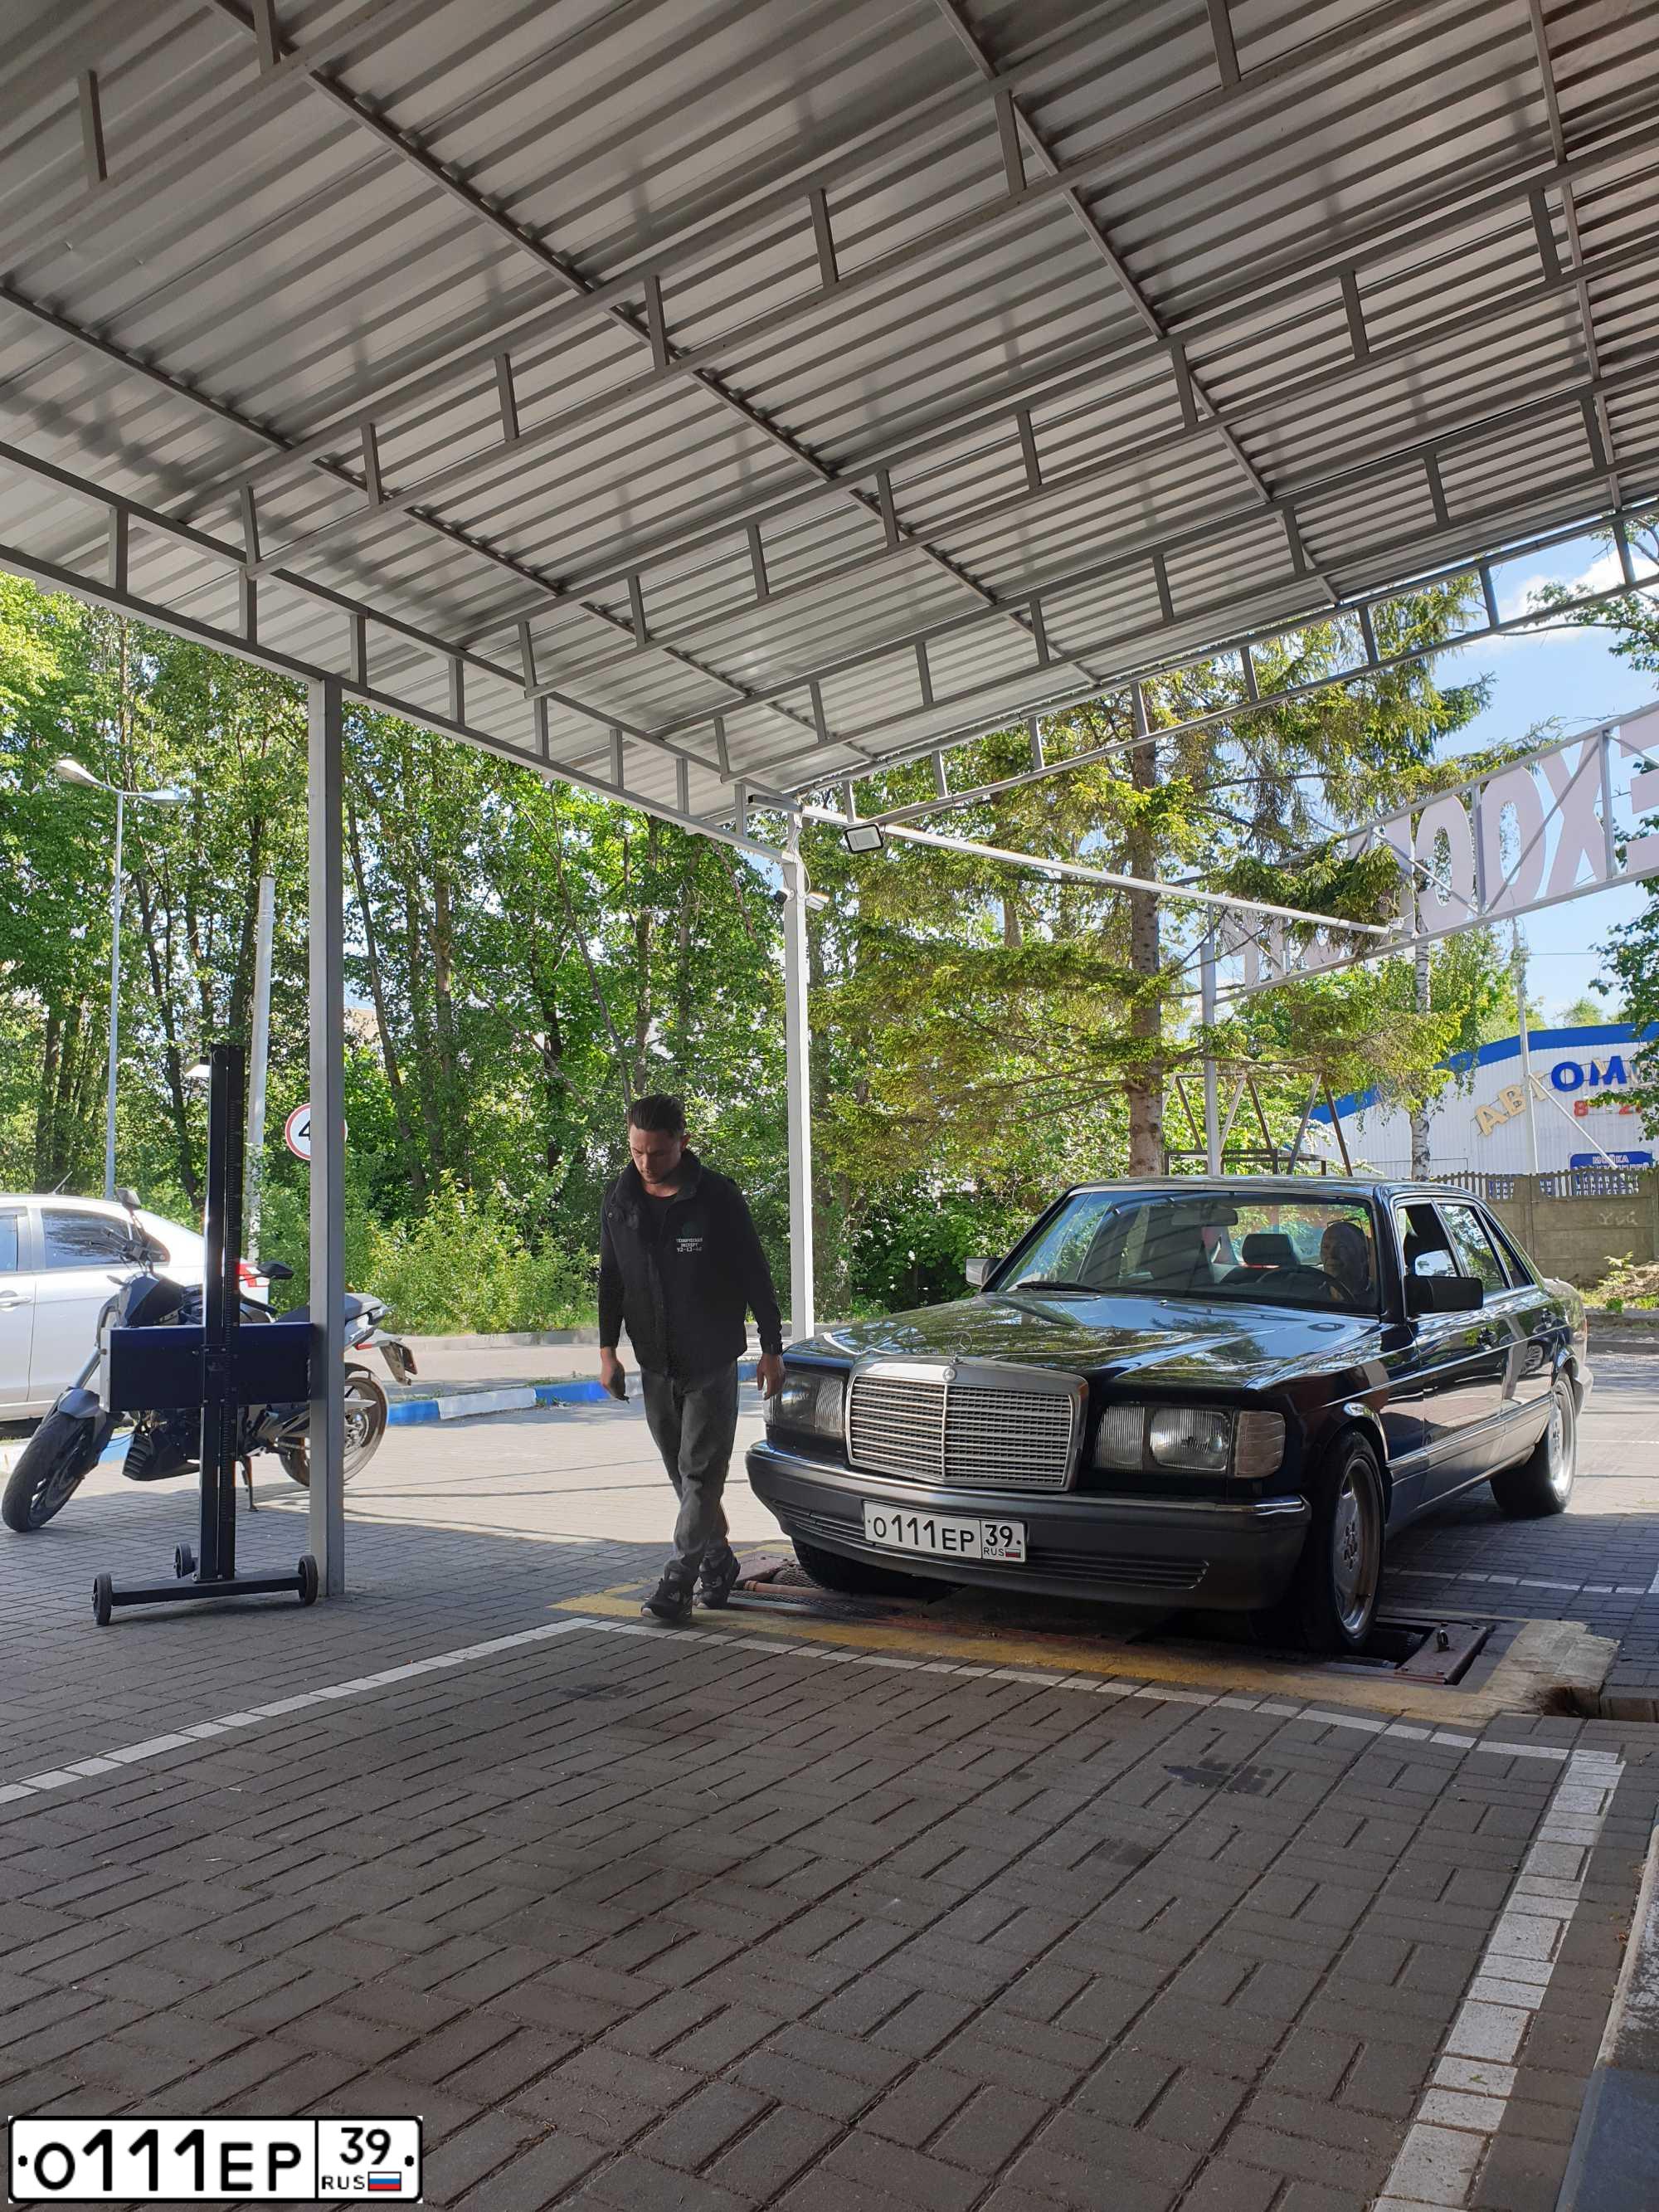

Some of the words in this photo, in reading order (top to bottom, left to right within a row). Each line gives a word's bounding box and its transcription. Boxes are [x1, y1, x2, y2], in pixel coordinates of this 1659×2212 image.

[298, 1119, 311, 1141] 4
[873, 1514, 975, 1552] О111ЕР
[985, 1524, 1013, 1548] 39
[983, 1547, 1005, 1557] RUS
